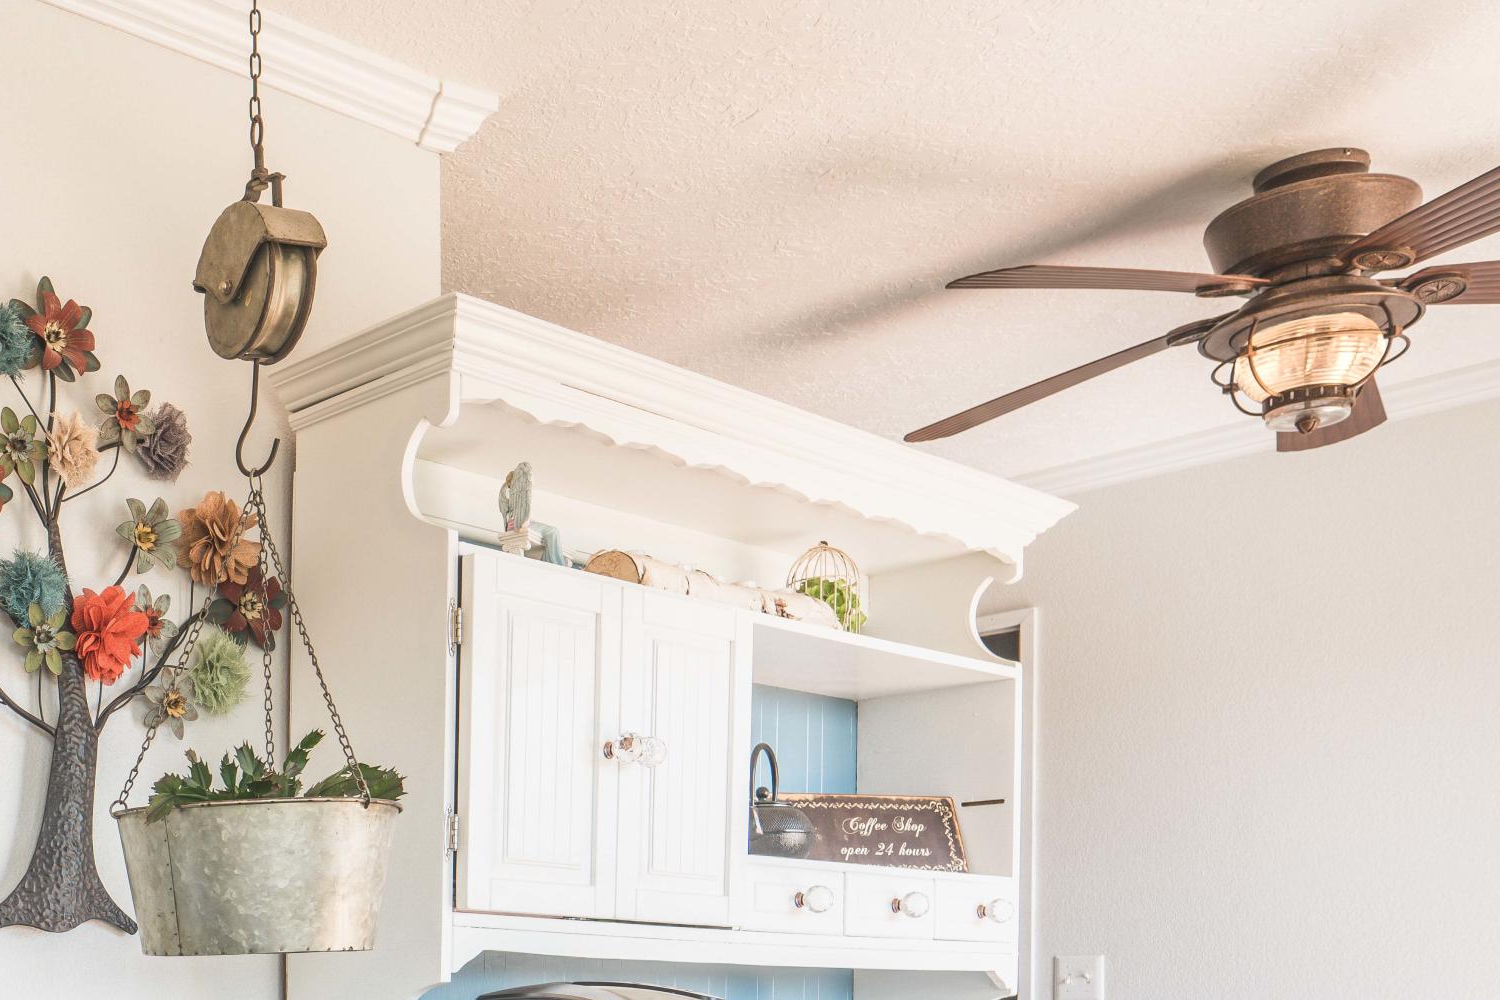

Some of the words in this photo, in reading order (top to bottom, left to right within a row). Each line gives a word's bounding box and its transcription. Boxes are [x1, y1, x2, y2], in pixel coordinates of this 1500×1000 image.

[842, 816, 888, 837] Coffee
[892, 815, 926, 837] Shop
[841, 845, 870, 861] open
[875, 842, 894, 856] 24
[898, 842, 932, 857] hours
